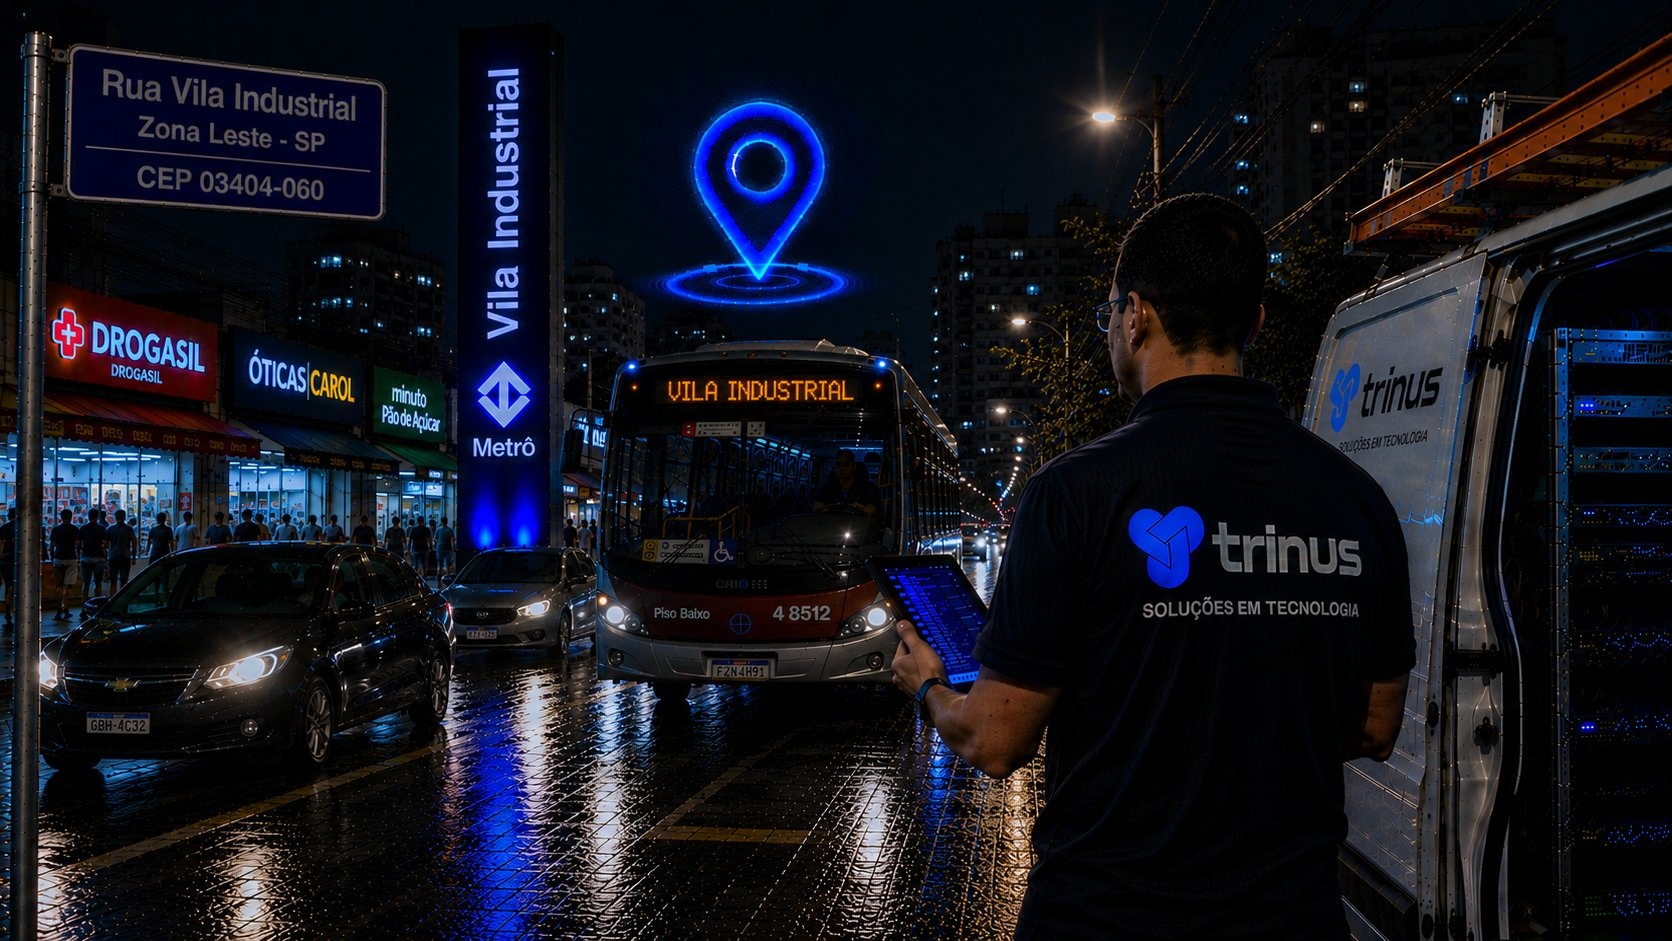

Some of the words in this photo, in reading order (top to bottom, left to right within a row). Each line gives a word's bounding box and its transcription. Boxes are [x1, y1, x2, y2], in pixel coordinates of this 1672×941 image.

[102, 69, 162, 102] Rua
[171, 76, 224, 108] Vila
[235, 83, 358, 121] Industrial
[138, 115, 200, 143] Zona
[209, 123, 272, 150] Leste
[294, 131, 326, 153] SP
[487, 69, 519, 248] Industrial
[137, 166, 192, 191] CEP
[200, 171, 325, 200] 03404-060
[487, 266, 519, 340] Vila
[92, 321, 205, 373] DROGASIL
[111, 363, 163, 385] DROGASIL
[248, 349, 307, 392] ÓTICAS
[310, 370, 355, 403] CAROL
[391, 384, 427, 408] minuto
[668, 380, 718, 401] VILA
[727, 380, 855, 401] INDUSTRIAL
[1361, 366, 1444, 418] trinus
[382, 404, 400, 425] Pão
[400, 408, 412, 427] de
[412, 410, 440, 434] Açúcar
[472, 436, 536, 457] Metrô
[1211, 521, 1362, 577] trinus
[654, 607, 677, 619] Piso
[680, 607, 711, 620] Baixo
[772, 605, 785, 621] 4
[788, 605, 831, 621] 8512
[1142, 596, 1234, 621] SOLUÇÕES
[1238, 601, 1261, 616] EM
[1265, 601, 1360, 618] TECNOLOGIA
[91, 719, 147, 732] GBH-4C32
